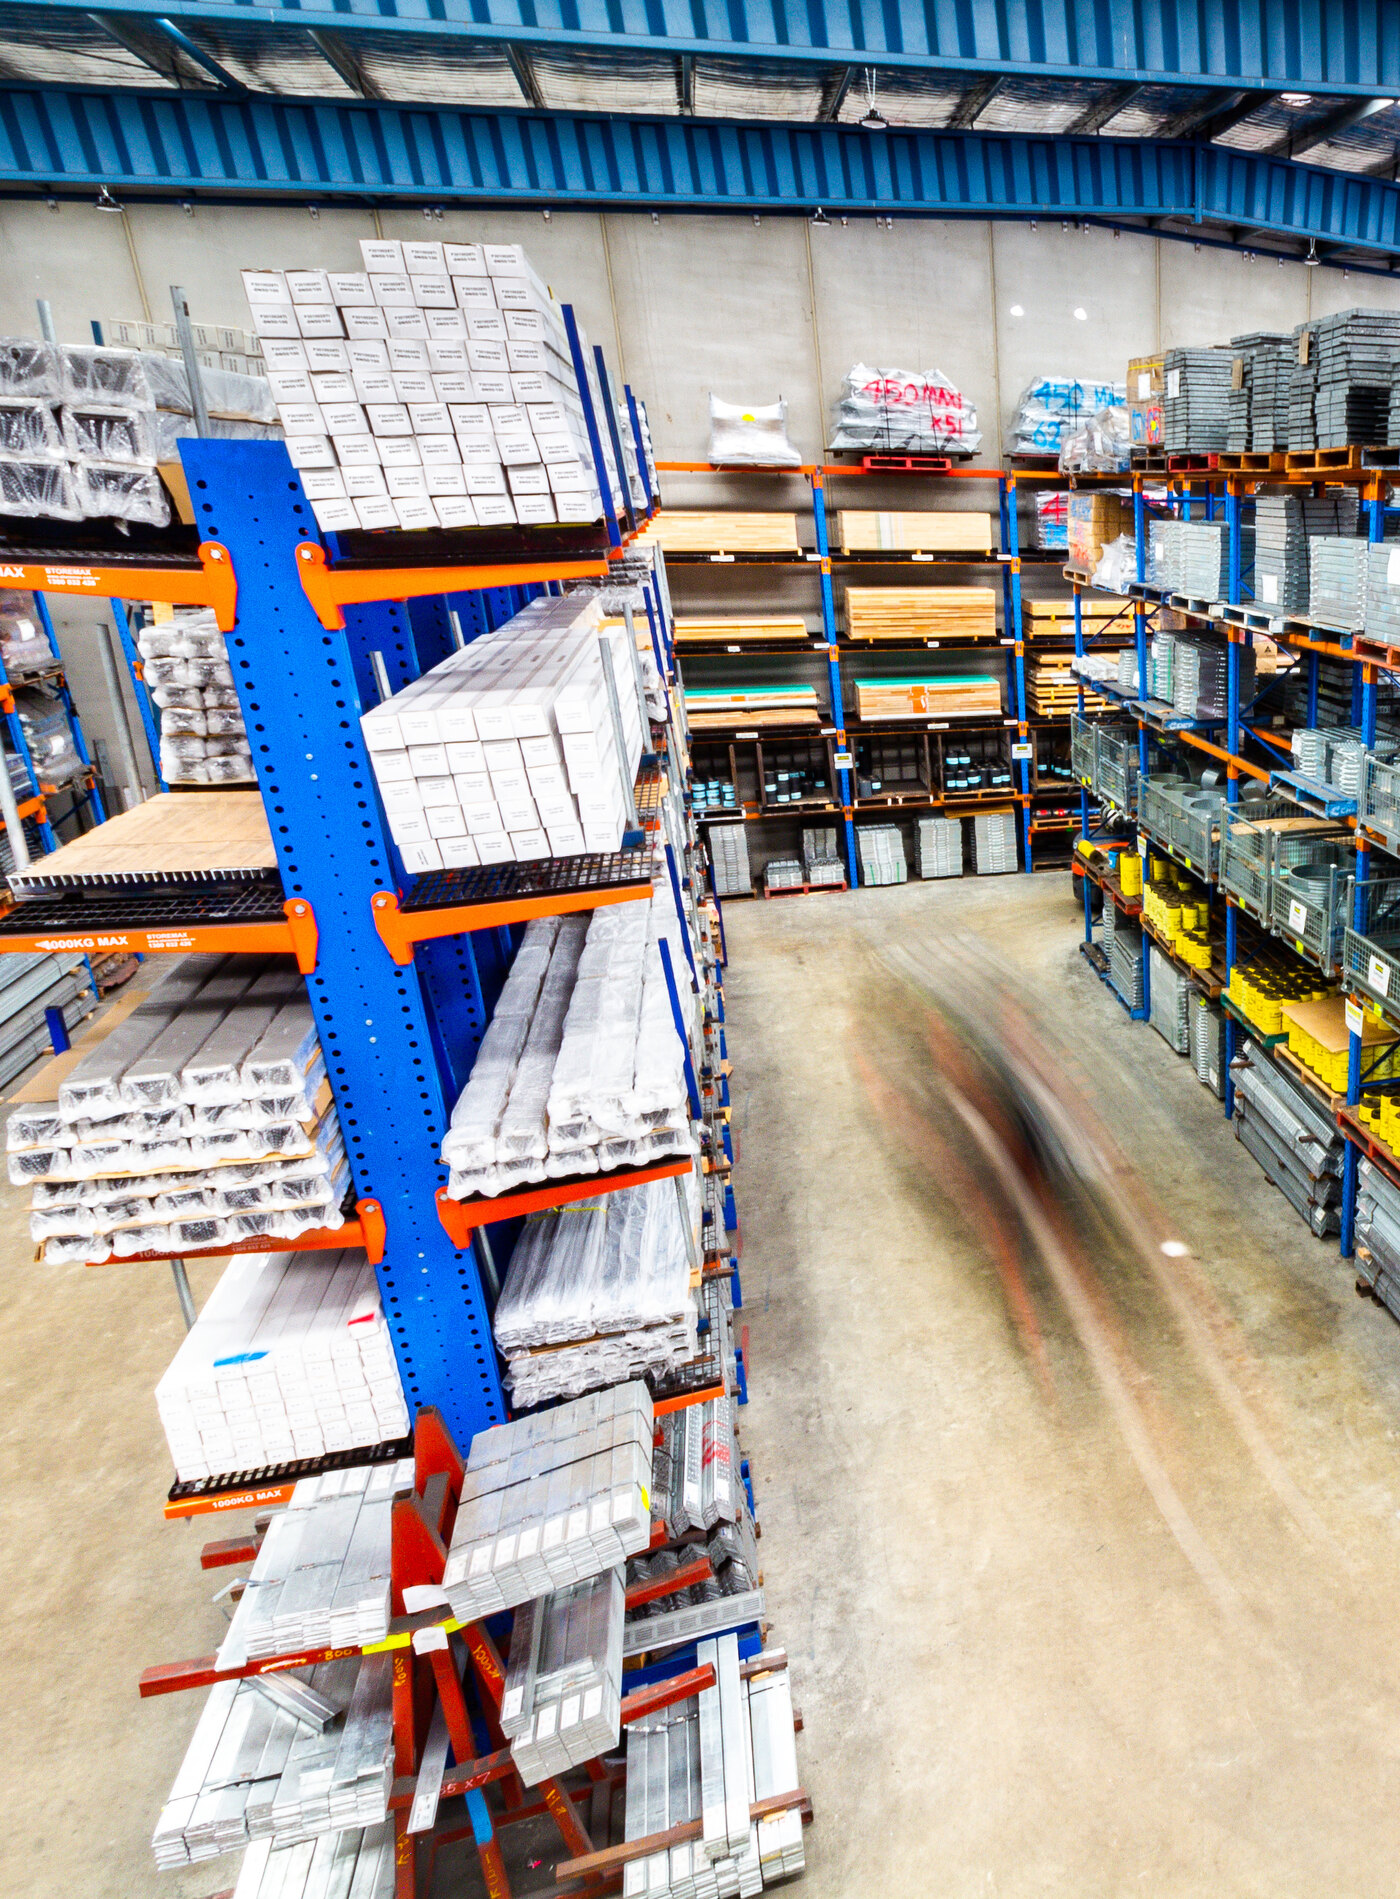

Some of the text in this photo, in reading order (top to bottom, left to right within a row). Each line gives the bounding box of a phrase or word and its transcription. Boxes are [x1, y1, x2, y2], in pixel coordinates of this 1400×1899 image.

[862, 379, 919, 406] 450
[0, 566, 26, 578] AX
[45, 567, 92, 575] STOREMAX
[97, 936, 128, 946] MAX
[212, 1489, 282, 1509] 1000KG MAX
